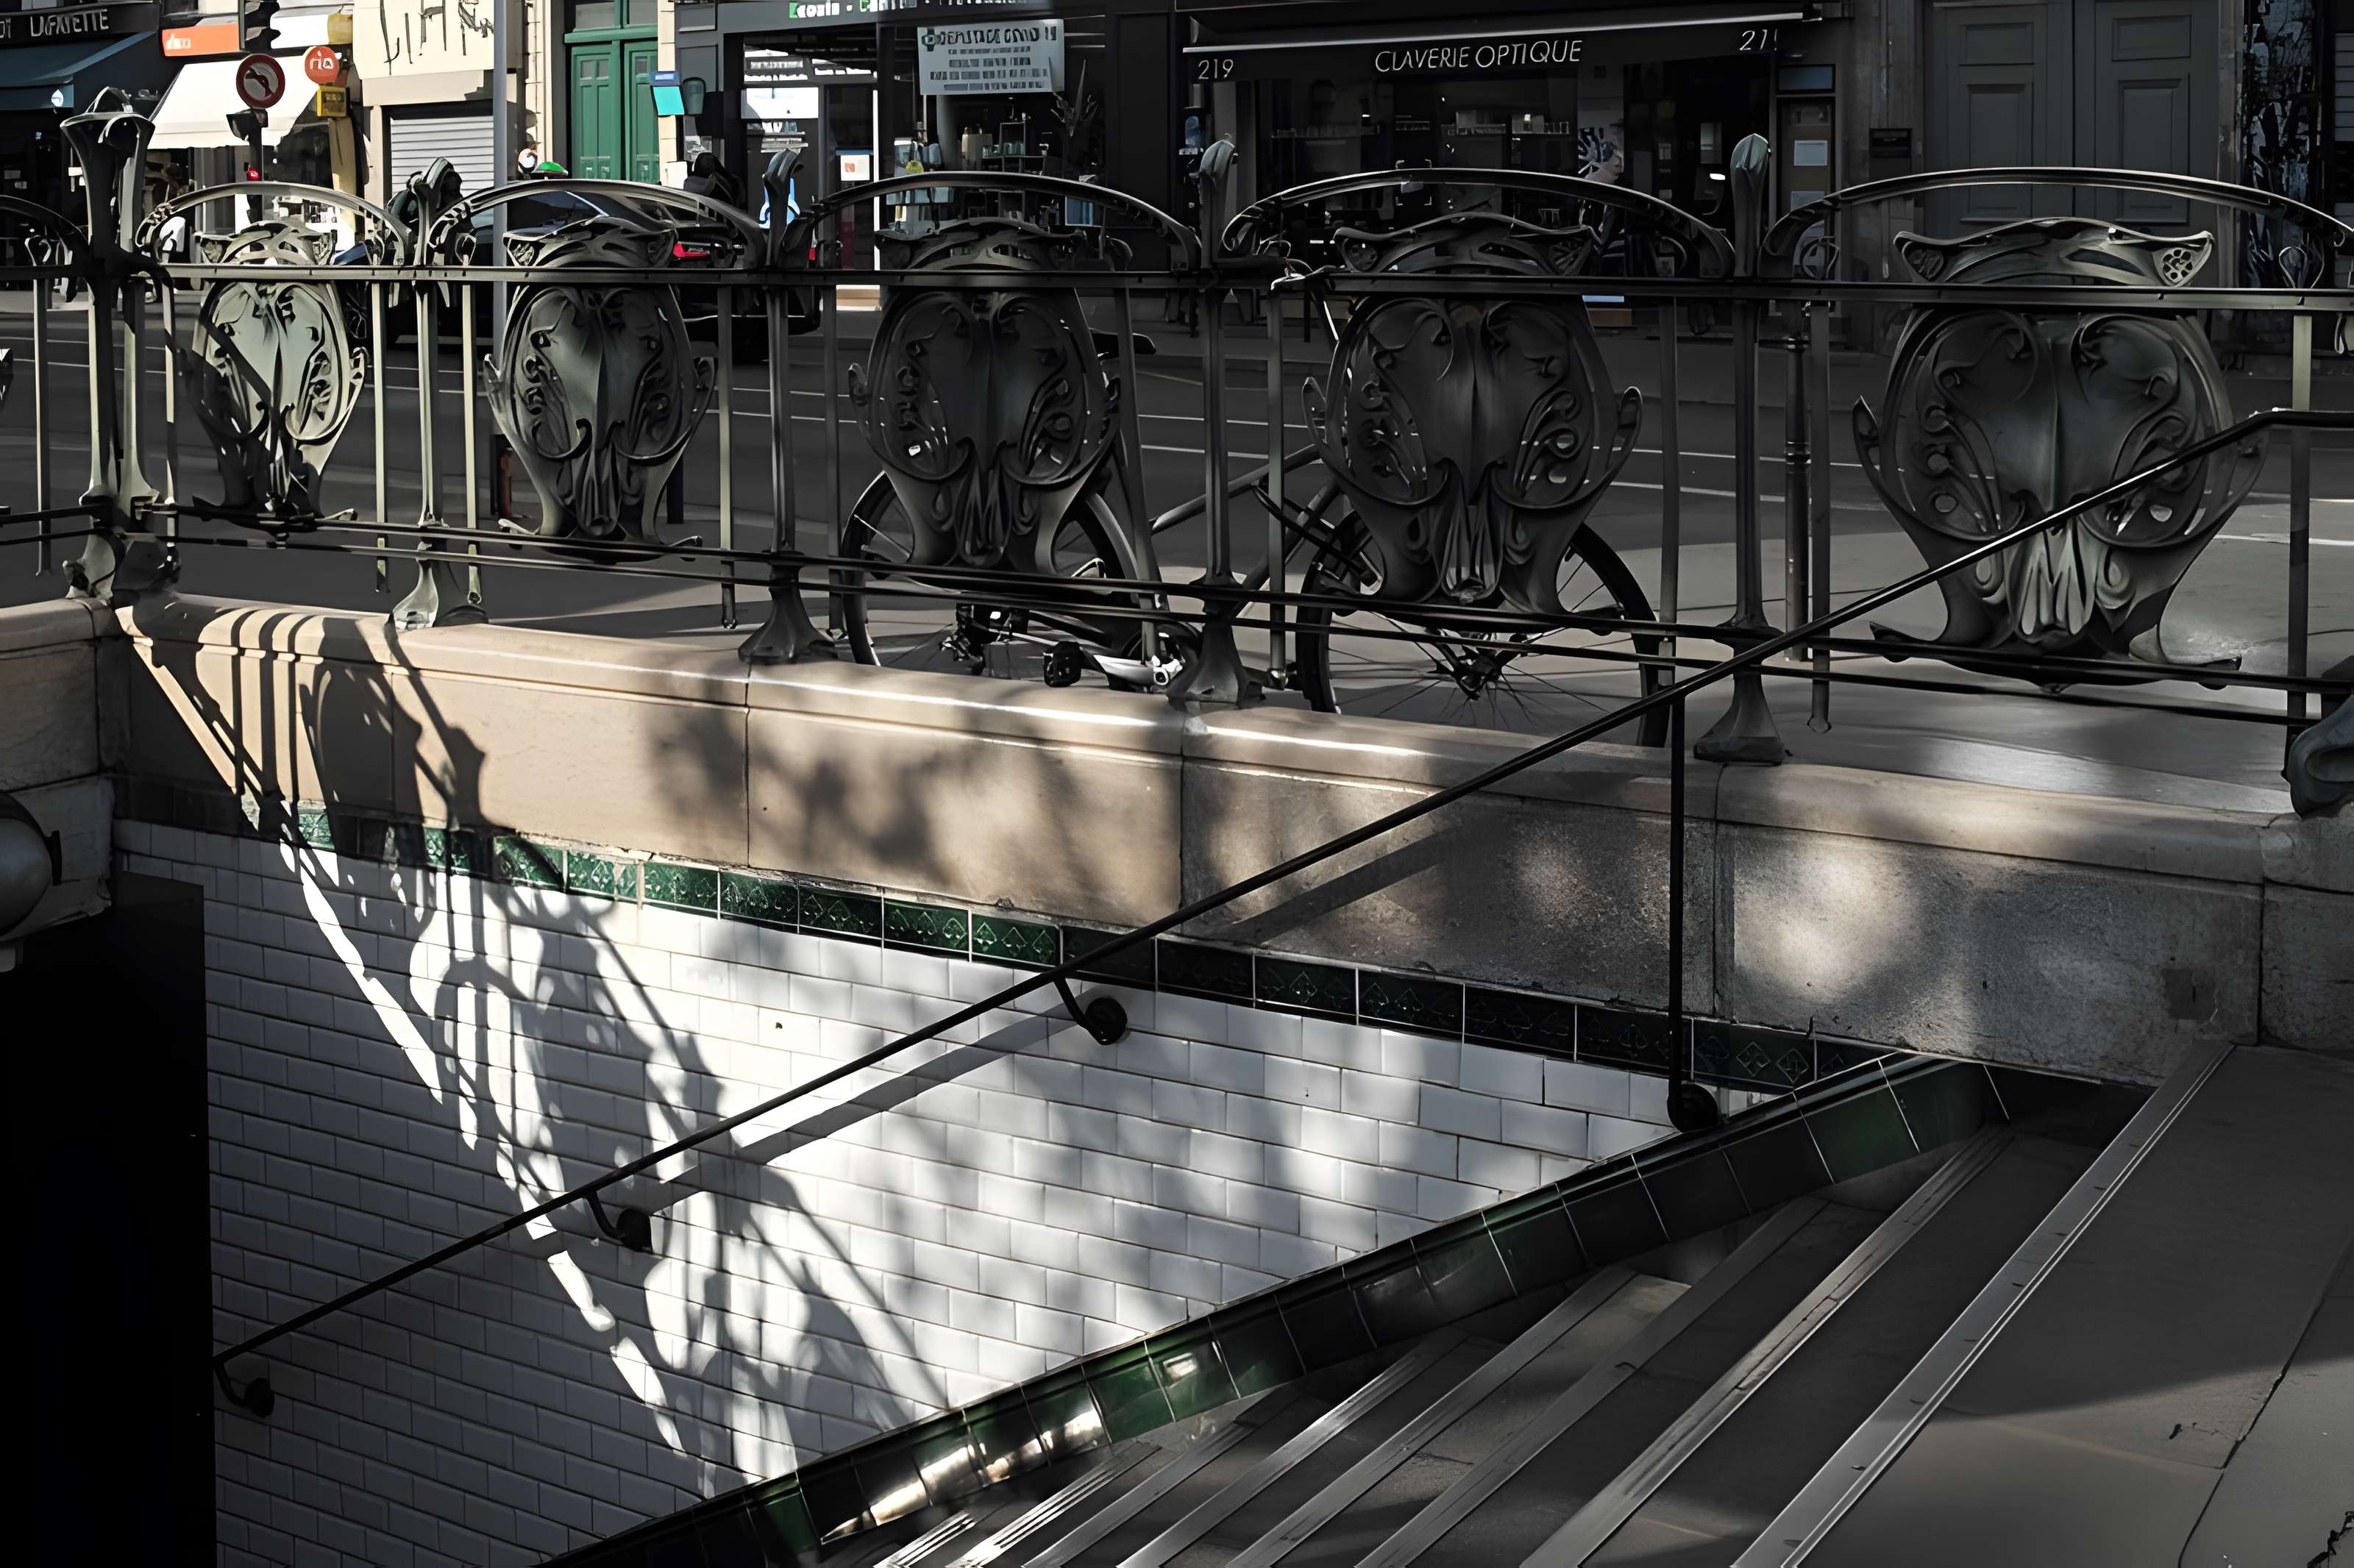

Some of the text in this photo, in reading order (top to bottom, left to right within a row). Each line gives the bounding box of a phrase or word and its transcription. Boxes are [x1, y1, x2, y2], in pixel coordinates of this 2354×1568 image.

[1198, 59, 1234, 79] 219
[1375, 40, 1583, 72] CLAVERIE OPTIQUE
